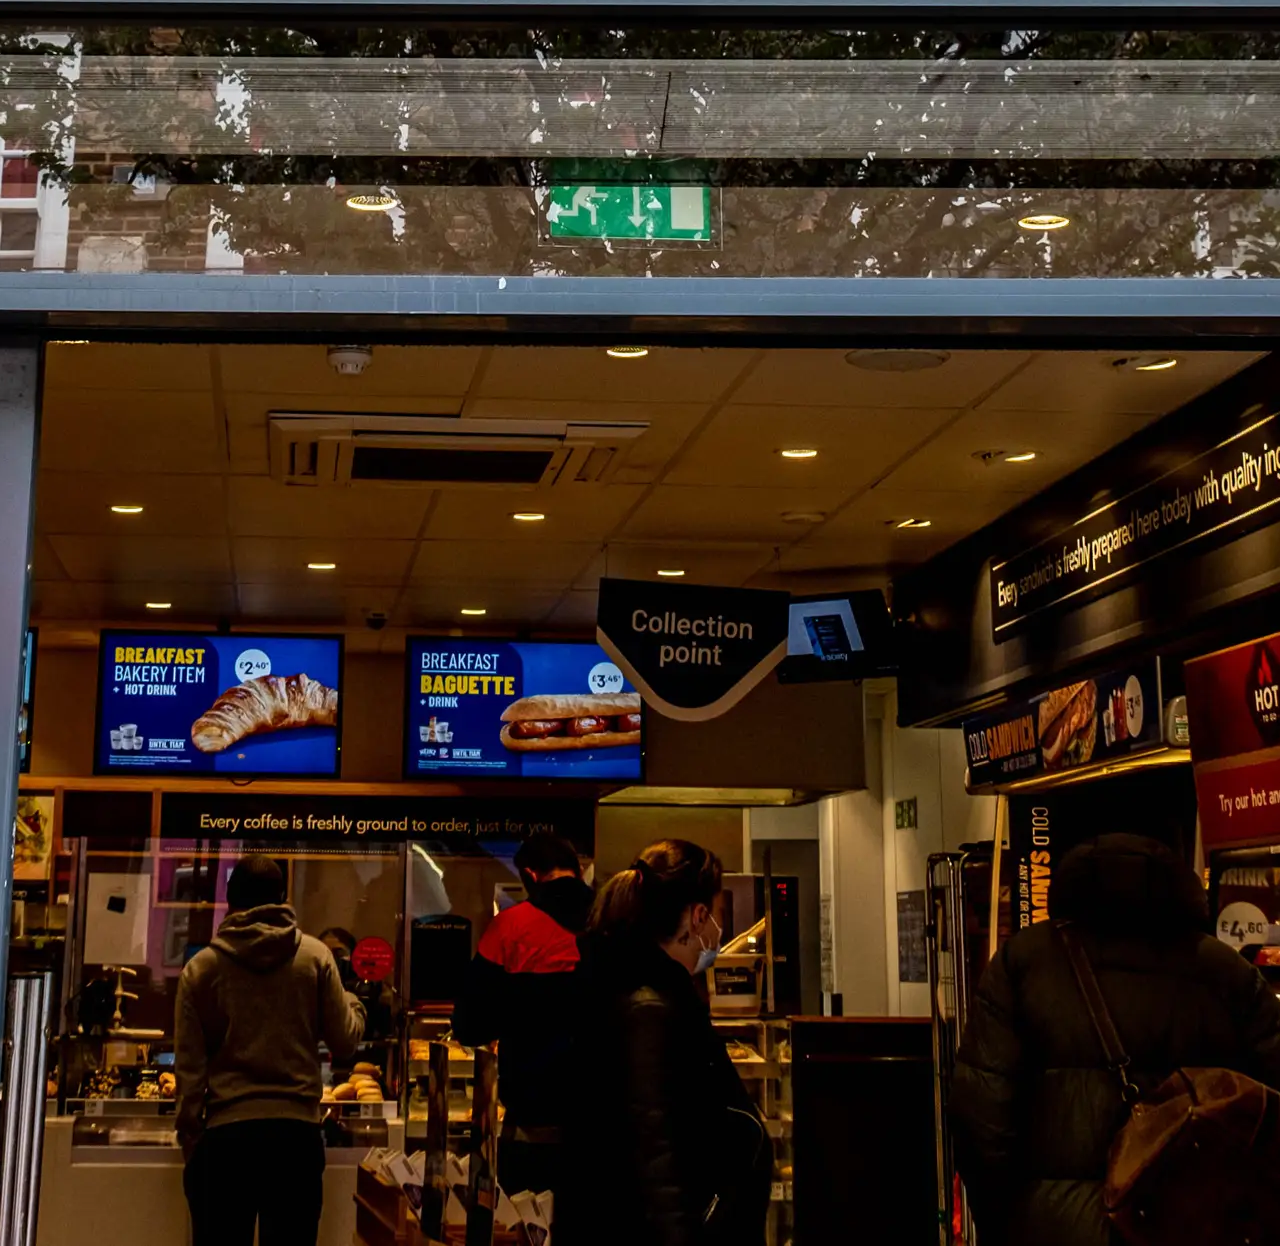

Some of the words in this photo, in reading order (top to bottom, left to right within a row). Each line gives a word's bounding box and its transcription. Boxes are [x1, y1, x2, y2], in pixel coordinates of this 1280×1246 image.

[997, 580, 1018, 607] Every
[1063, 538, 1090, 574] freshly
[1091, 516, 1134, 570] prepared
[1136, 507, 1160, 537] here
[1161, 490, 1192, 524] today
[1194, 475, 1220, 509] with
[1221, 452, 1262, 504] quality
[631, 609, 753, 640] Collection
[114, 647, 206, 665] BREAKFAST
[421, 653, 500, 670] BREAKFAST
[659, 641, 722, 667] point
[114, 665, 168, 682] BAKERY
[173, 666, 206, 683] ITEM
[124, 684, 144, 695] HOT
[147, 684, 177, 696] DRINK
[420, 675, 516, 696] BAGUETTE
[428, 696, 459, 708] DRINK
[1254, 685, 1279, 712] HOT
[969, 731, 988, 761] COLD
[986, 715, 1036, 762] SANDWICH
[1219, 792, 1233, 817] Try
[1235, 789, 1249, 812] our
[1251, 785, 1266, 809] hot
[200, 814, 240, 832] Every
[244, 814, 288, 829] coffee
[292, 816, 303, 829] is
[307, 816, 352, 834] freshly
[357, 817, 408, 834] ground
[412, 820, 426, 831] to
[431, 819, 470, 833] order,
[475, 819, 500, 835] just
[505, 819, 523, 832] for
[529, 823, 554, 835] you
[1032, 807, 1049, 846] COLD
[1019, 864, 1028, 880] ANY
[1019, 882, 1029, 898] HOT
[1030, 850, 1051, 925] SANDW
[1020, 900, 1029, 911] OR
[1020, 913, 1030, 929] COL
